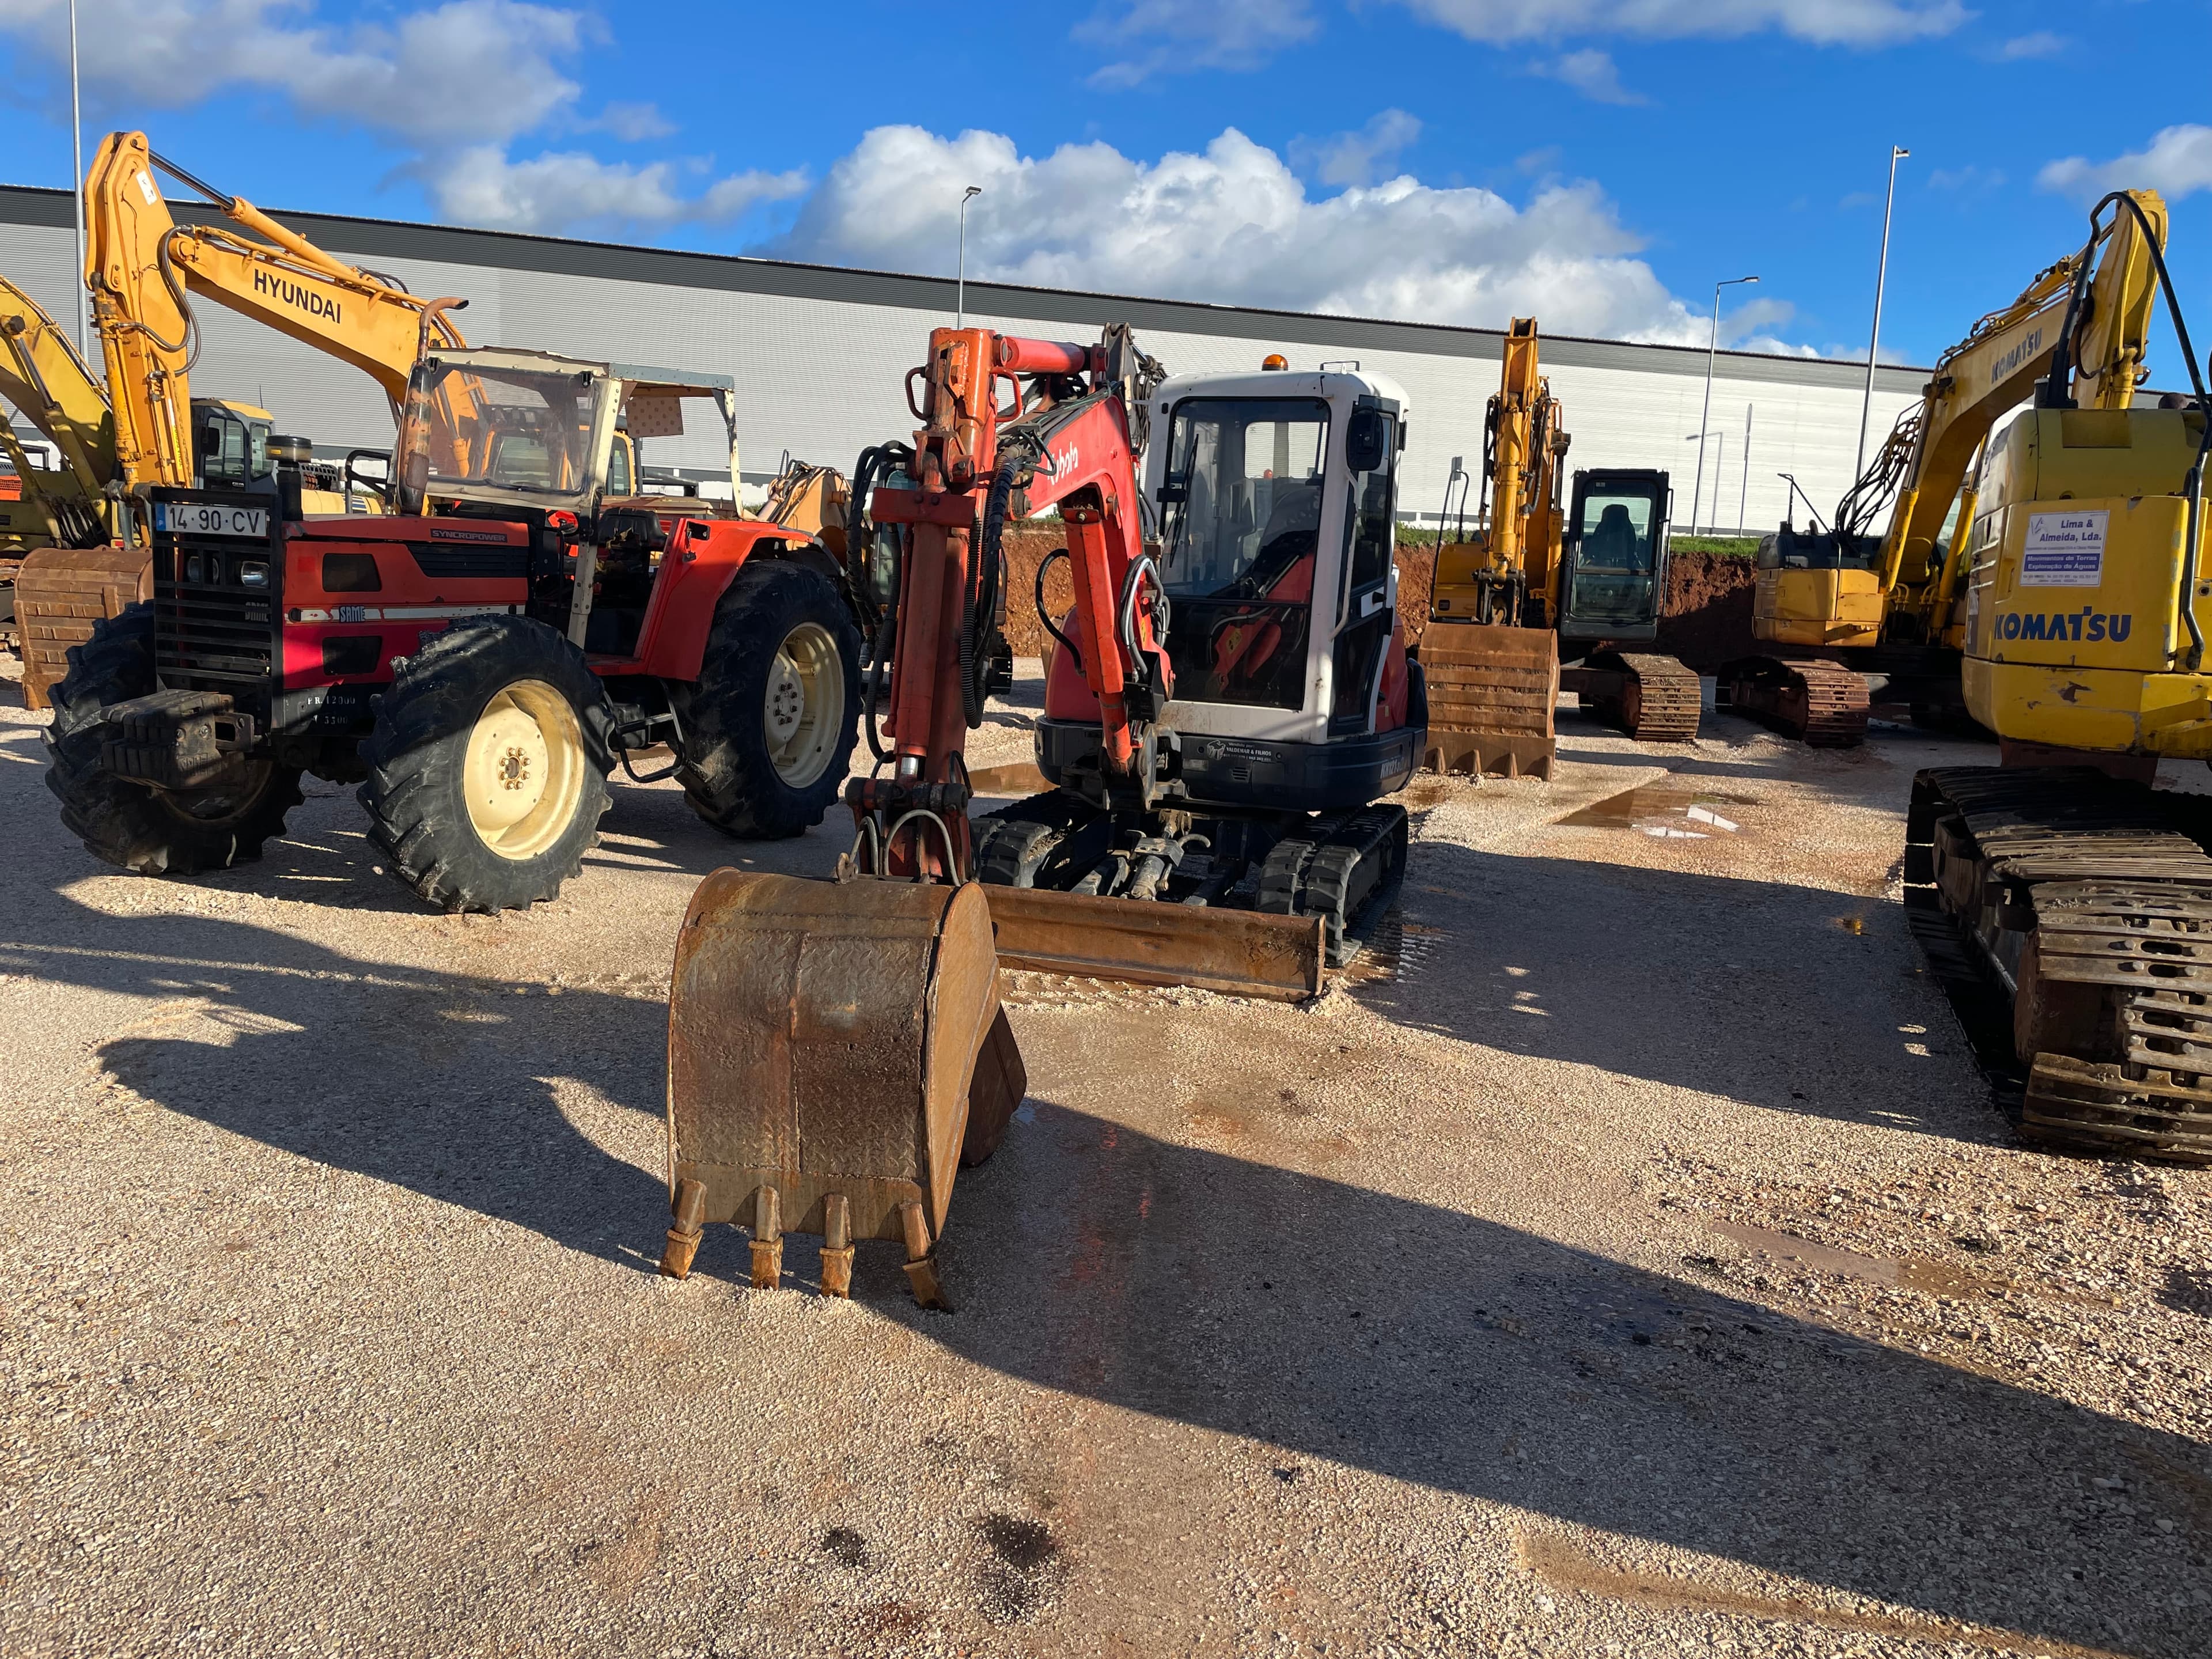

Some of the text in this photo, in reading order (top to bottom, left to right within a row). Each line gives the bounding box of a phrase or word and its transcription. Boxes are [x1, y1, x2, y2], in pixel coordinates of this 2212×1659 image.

[254, 268, 340, 324] HYUNDAI
[1991, 327, 2042, 384] KOMATSU
[2061, 519, 2093, 529] Lima &
[432, 530, 506, 541] SYNCROPOWER
[2039, 532, 2102, 543] Almeida, Lda.
[339, 606, 365, 623] SAME
[1994, 606, 2132, 643] KOMATSU
[1226, 747, 1250, 755] VALDEMAR
